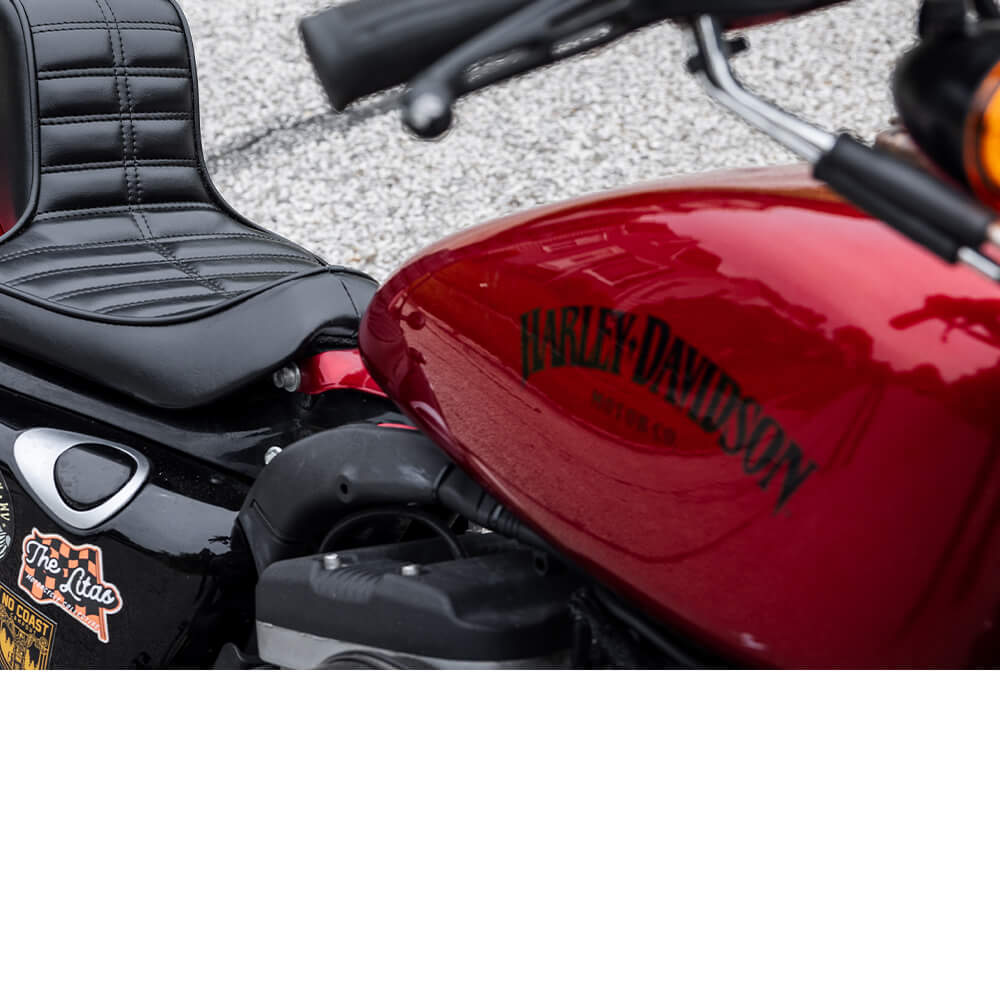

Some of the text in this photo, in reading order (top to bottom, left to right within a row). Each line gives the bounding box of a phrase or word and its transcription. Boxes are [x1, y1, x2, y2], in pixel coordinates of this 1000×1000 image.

[26, 540, 115, 605] The Litas
[2, 592, 15, 611] NO
[16, 605, 49, 636] COAST
